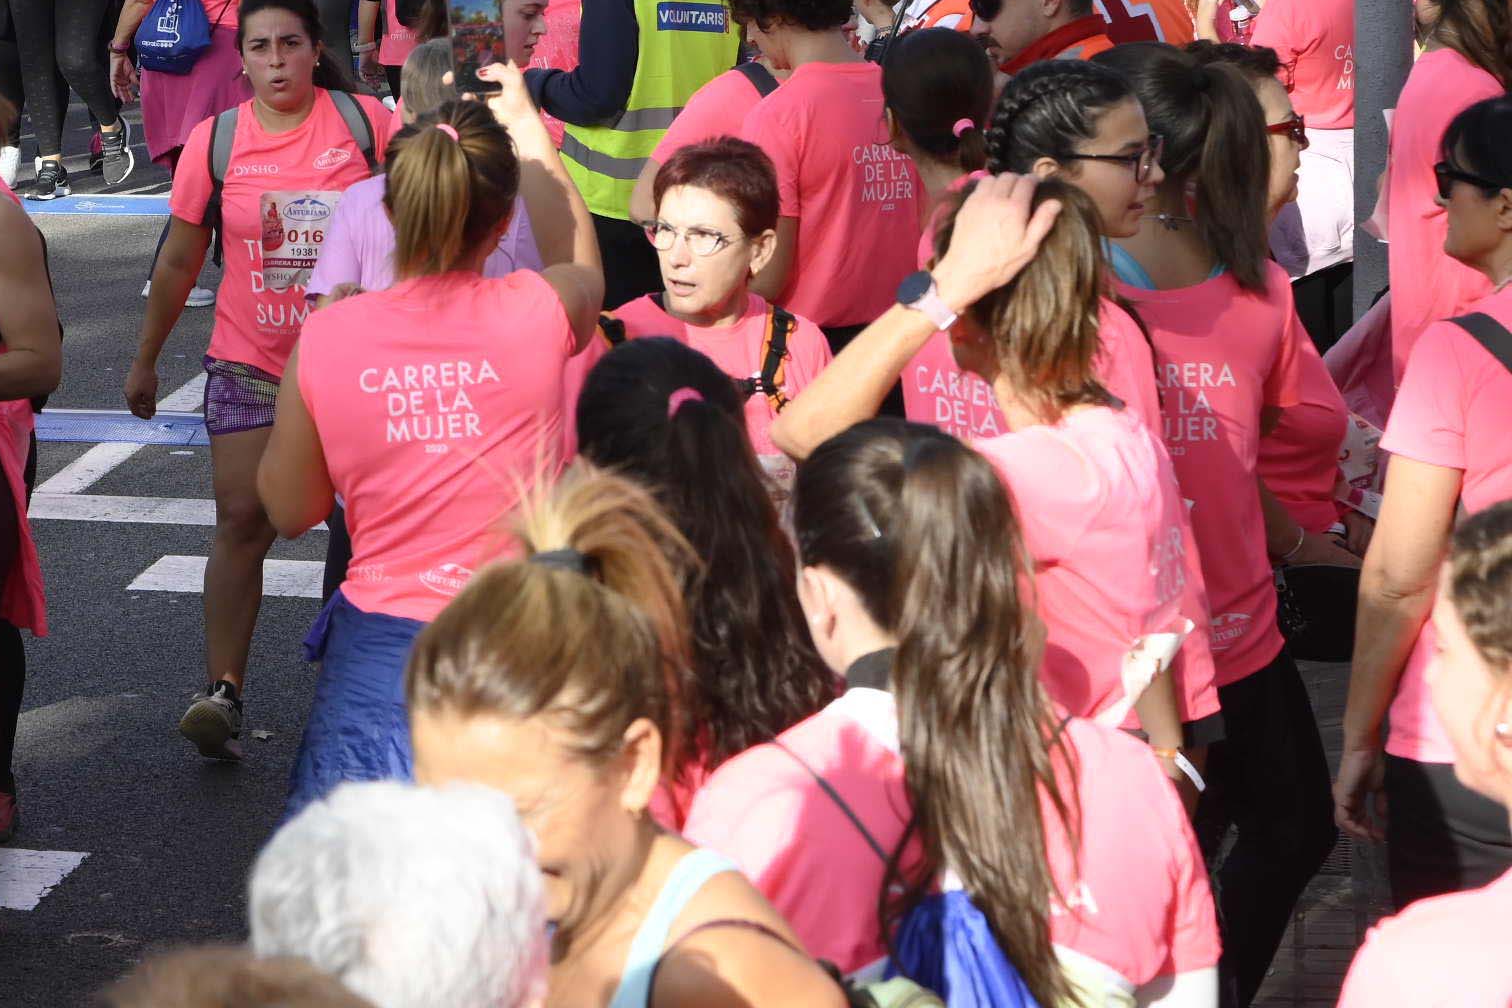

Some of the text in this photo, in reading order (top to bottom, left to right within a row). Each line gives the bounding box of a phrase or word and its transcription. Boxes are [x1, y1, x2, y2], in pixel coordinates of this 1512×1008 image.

[233, 164, 280, 176] OYSHO
[864, 162, 911, 183] DE LA
[861, 181, 913, 203] MUJER
[286, 206, 329, 218] ASTURIANA
[287, 229, 324, 244] 016
[291, 247, 319, 257] 19381
[359, 359, 500, 393] CARRERA
[388, 387, 474, 417] DE LA
[1178, 389, 1213, 415] LA
[386, 412, 484, 443] MUJER
[935, 396, 966, 426] DE
[968, 406, 1000, 437] LA
